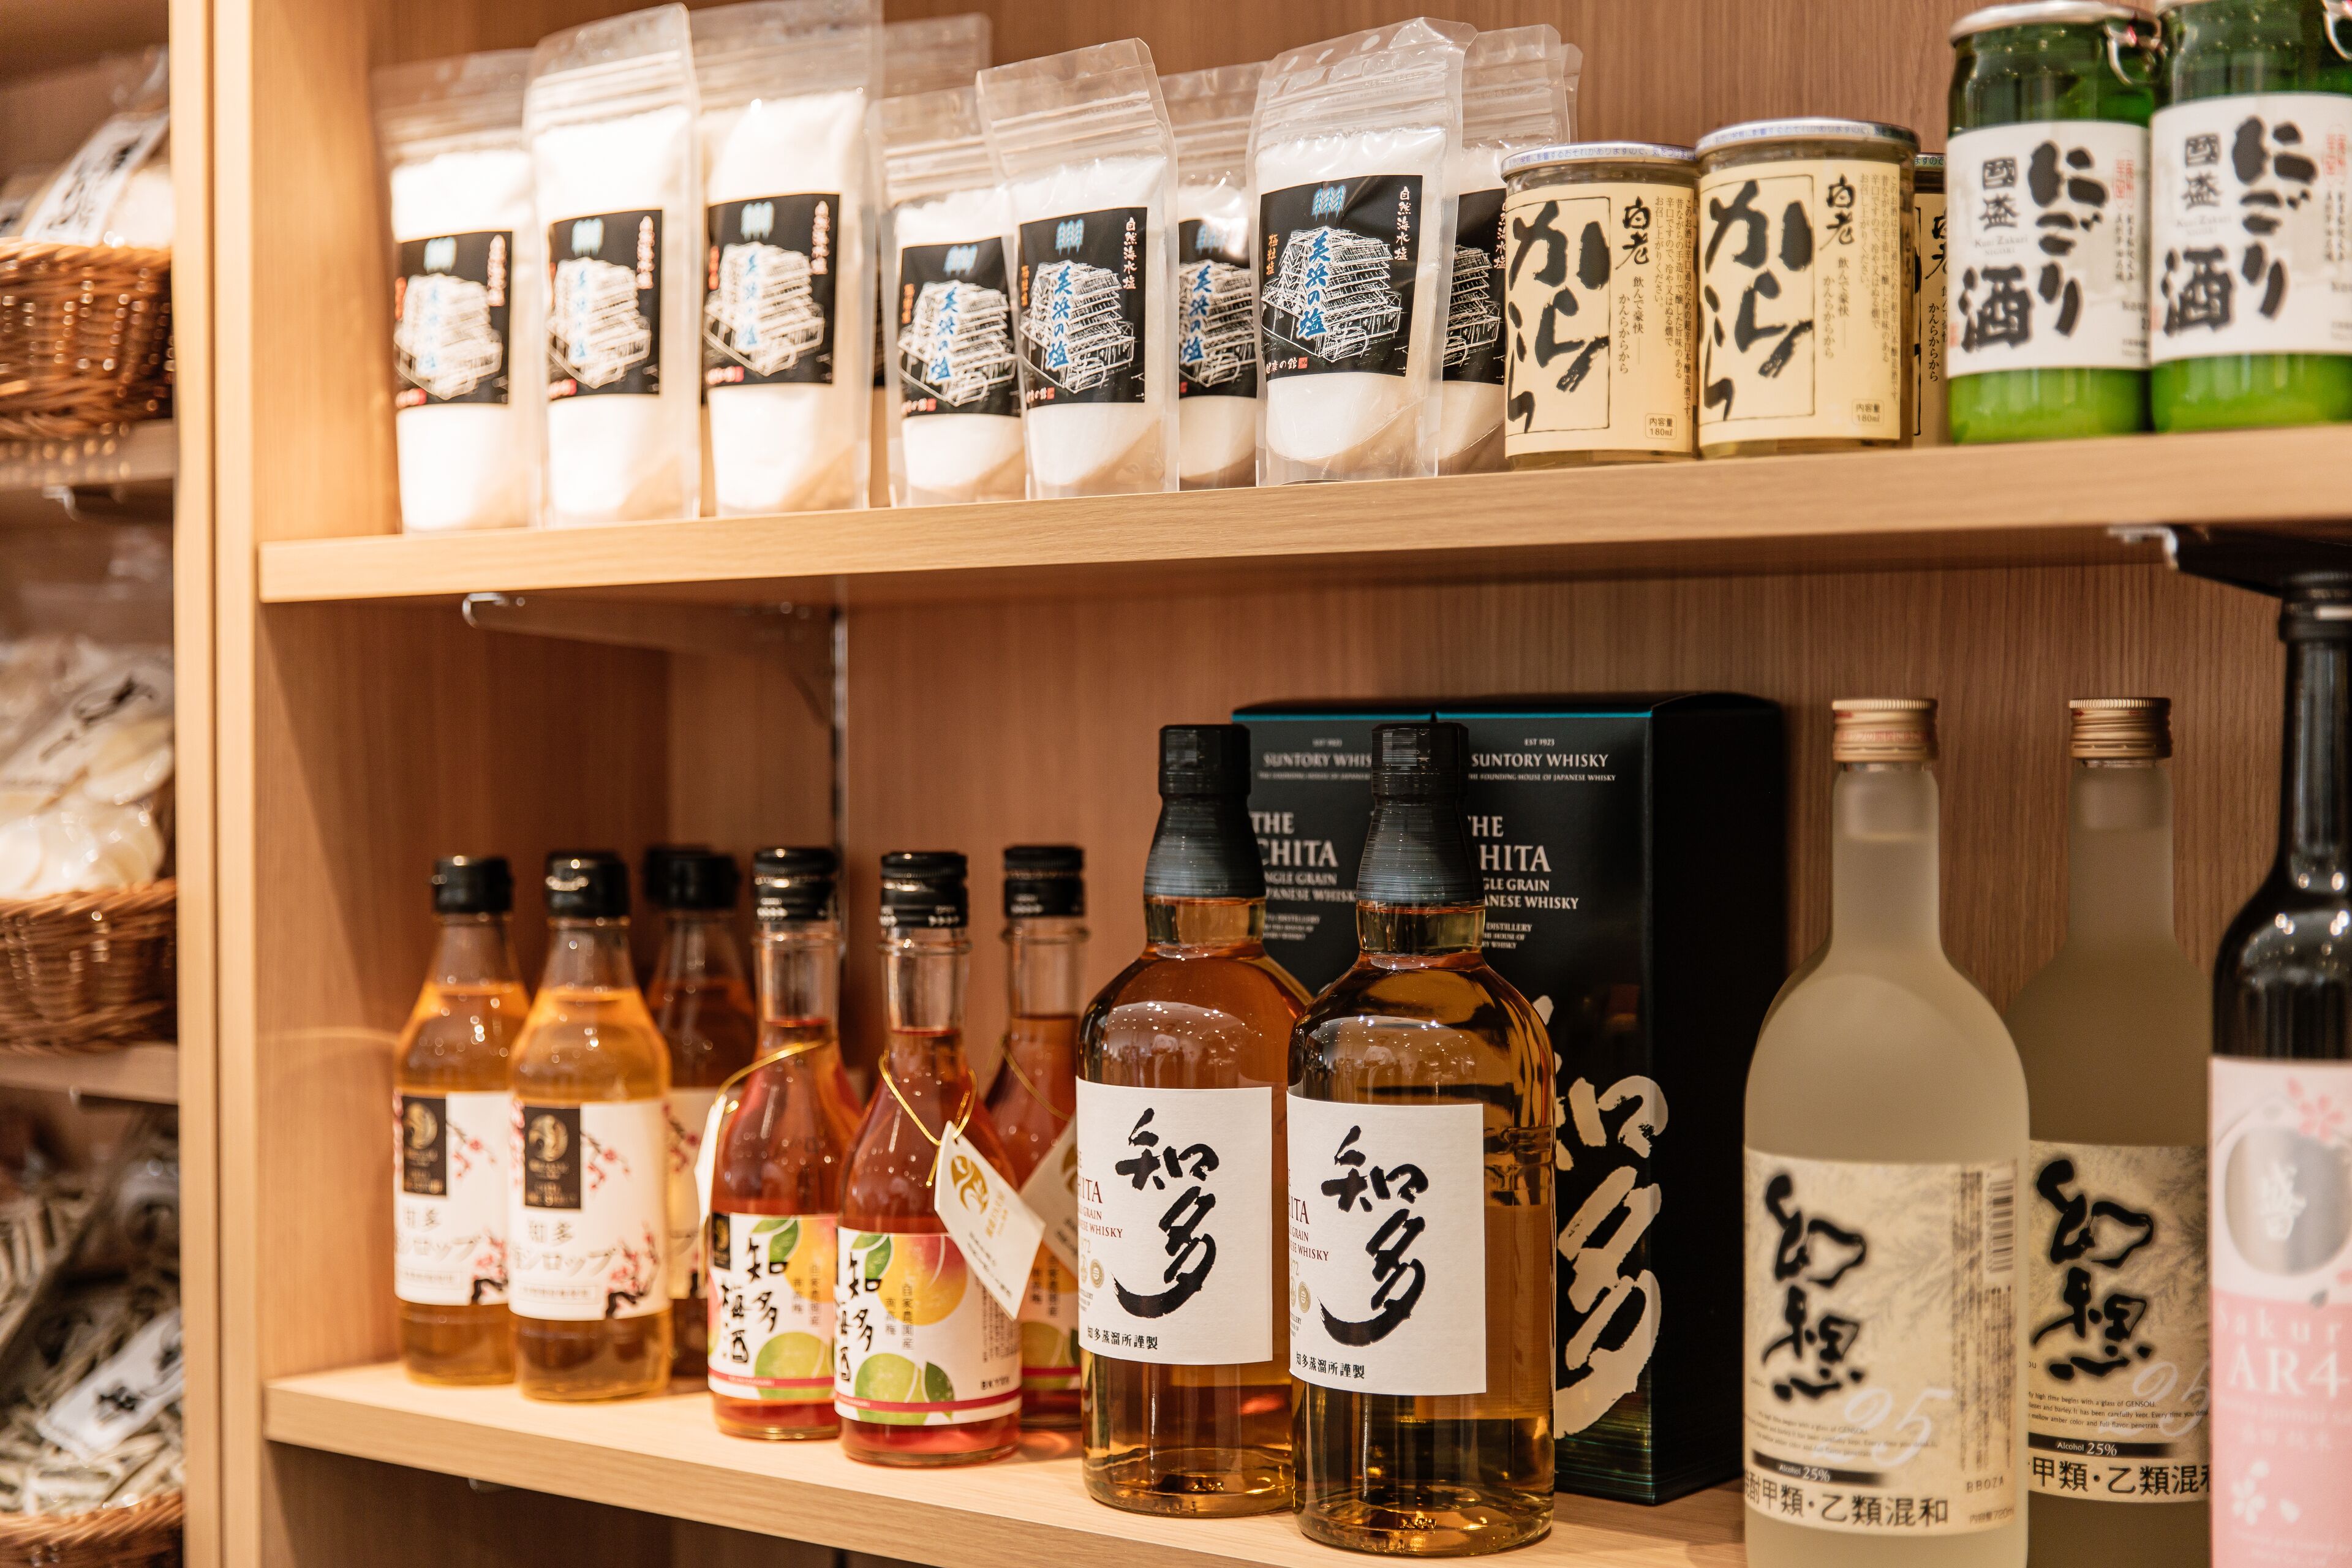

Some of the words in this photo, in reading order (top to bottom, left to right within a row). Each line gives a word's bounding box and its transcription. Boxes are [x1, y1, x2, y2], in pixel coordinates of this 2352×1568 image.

[1393, 186, 1411, 261] 自然海水塩
[1819, 174, 1856, 252] 白老
[2231, 115, 2319, 321] にごり
[1615, 196, 1652, 270] 白老
[2027, 140, 2108, 337] にごり
[1298, 230, 1332, 337] 美浜の塩
[2160, 245, 2238, 338] 酒
[1823, 276, 1835, 359] かんらからから
[1959, 262, 2034, 354] 酒
[1619, 293, 1630, 375] かんらからから
[1928, 303, 1940, 382] かんらからから
[1855, 404, 1881, 414] 内容量
[1649, 417, 1674, 428] 内容量
[1332, 753, 1372, 767] WHIS
[1471, 753, 1543, 767] SUNTORY
[1545, 753, 1609, 767] WHISKY
[1248, 811, 1294, 834] THE
[1468, 815, 1504, 838] HE
[1479, 843, 1553, 873] HITA
[1483, 876, 1505, 891] GLE
[1506, 878, 1550, 892] GRAIN
[1484, 894, 1522, 908] ANESE
[1523, 895, 1580, 910] WHISKY
[1114, 1107, 1221, 1319] 知多
[1089, 1223, 1123, 1239] WHISKY
[1291, 1227, 1310, 1242] GRAIN
[1317, 1125, 1430, 1348] 知多
[1297, 1244, 1329, 1262] WHISKY
[2035, 1392, 2046, 1401] high
[2048, 1393, 2060, 1402] time
[2061, 1395, 2079, 1405] begins
[2101, 1400, 2115, 1408] glass
[2031, 1413, 2049, 1422] mellow
[2050, 1415, 2068, 1424] amber
[2108, 1410, 2133, 1419] carefully
[2056, 1441, 2085, 1452] Alcohol
[2086, 1442, 2118, 1457] 25%
[1779, 1464, 1801, 1476] Alcohol
[1802, 1466, 1831, 1483] 25%
